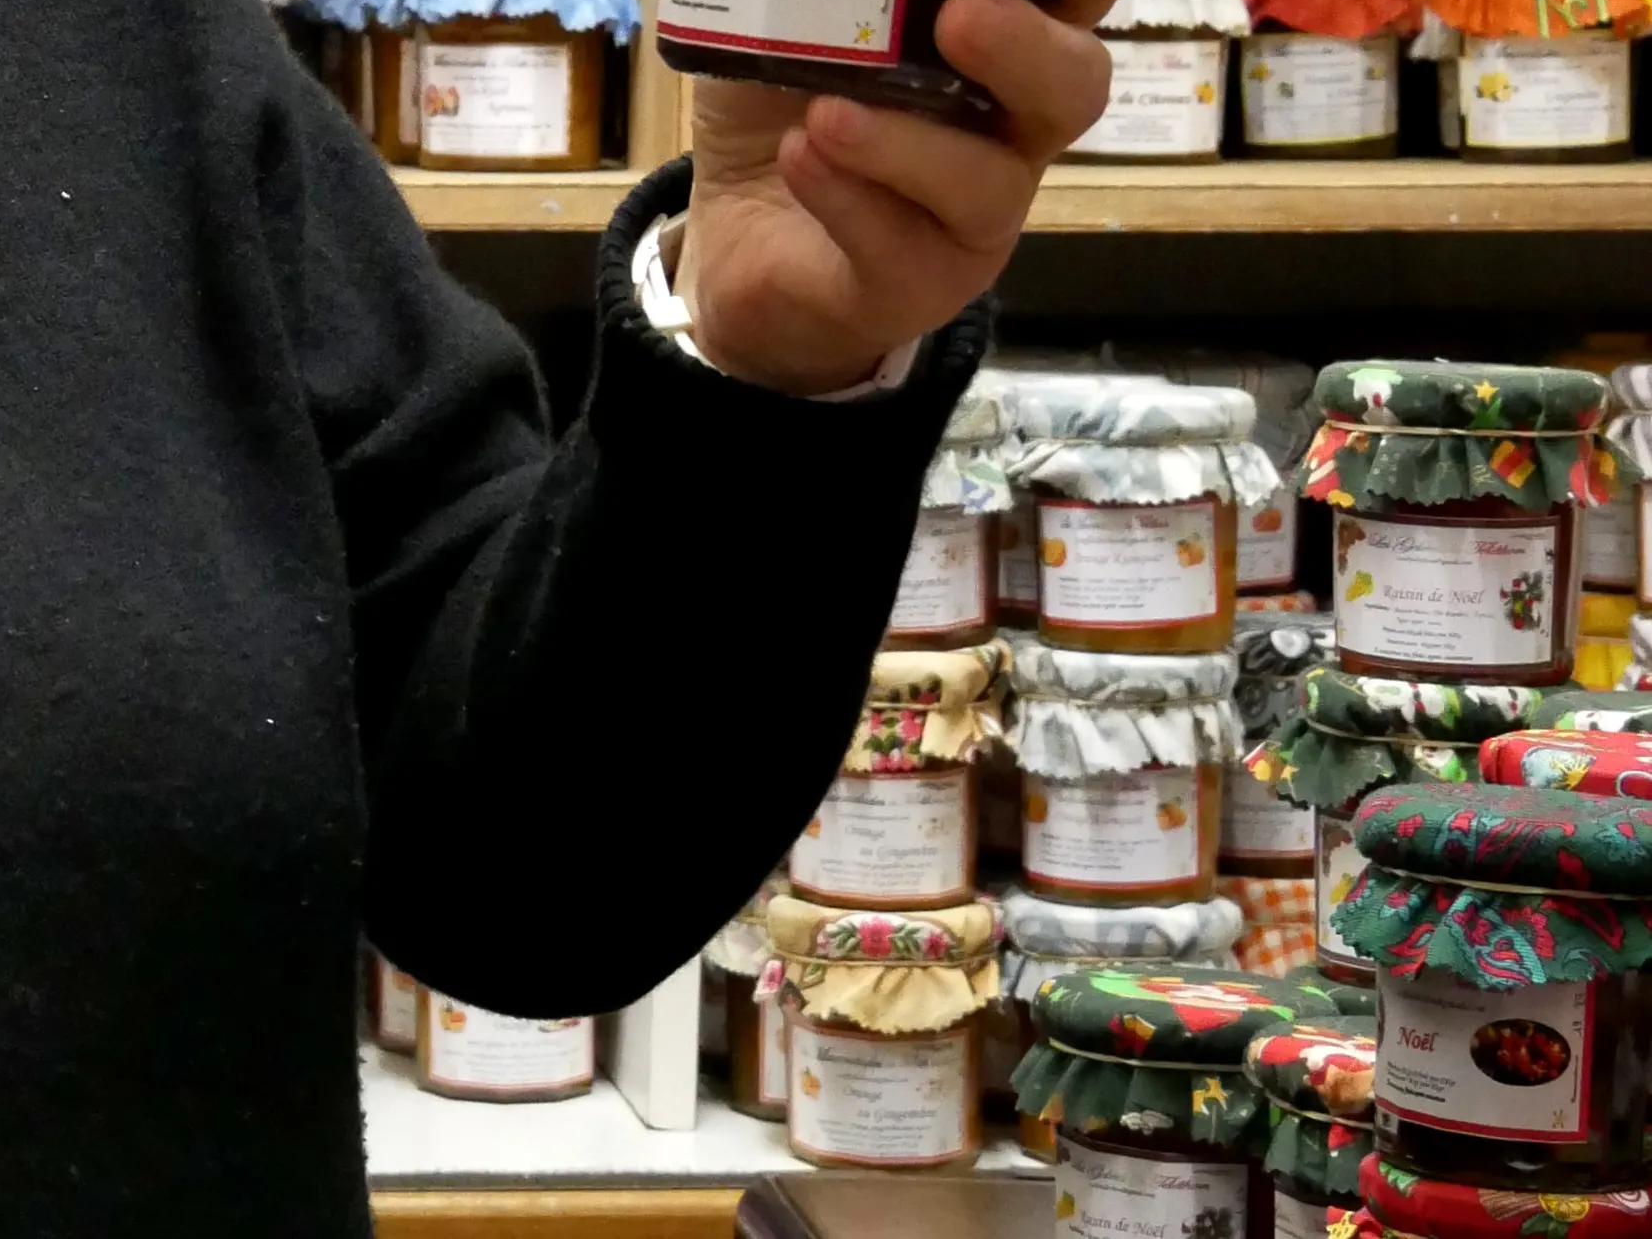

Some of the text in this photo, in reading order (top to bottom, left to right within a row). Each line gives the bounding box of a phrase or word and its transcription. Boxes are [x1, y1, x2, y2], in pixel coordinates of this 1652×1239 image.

[1427, 588, 1444, 602] de
[1447, 589, 1486, 605] Noël
[1397, 1026, 1439, 1052] Noël
